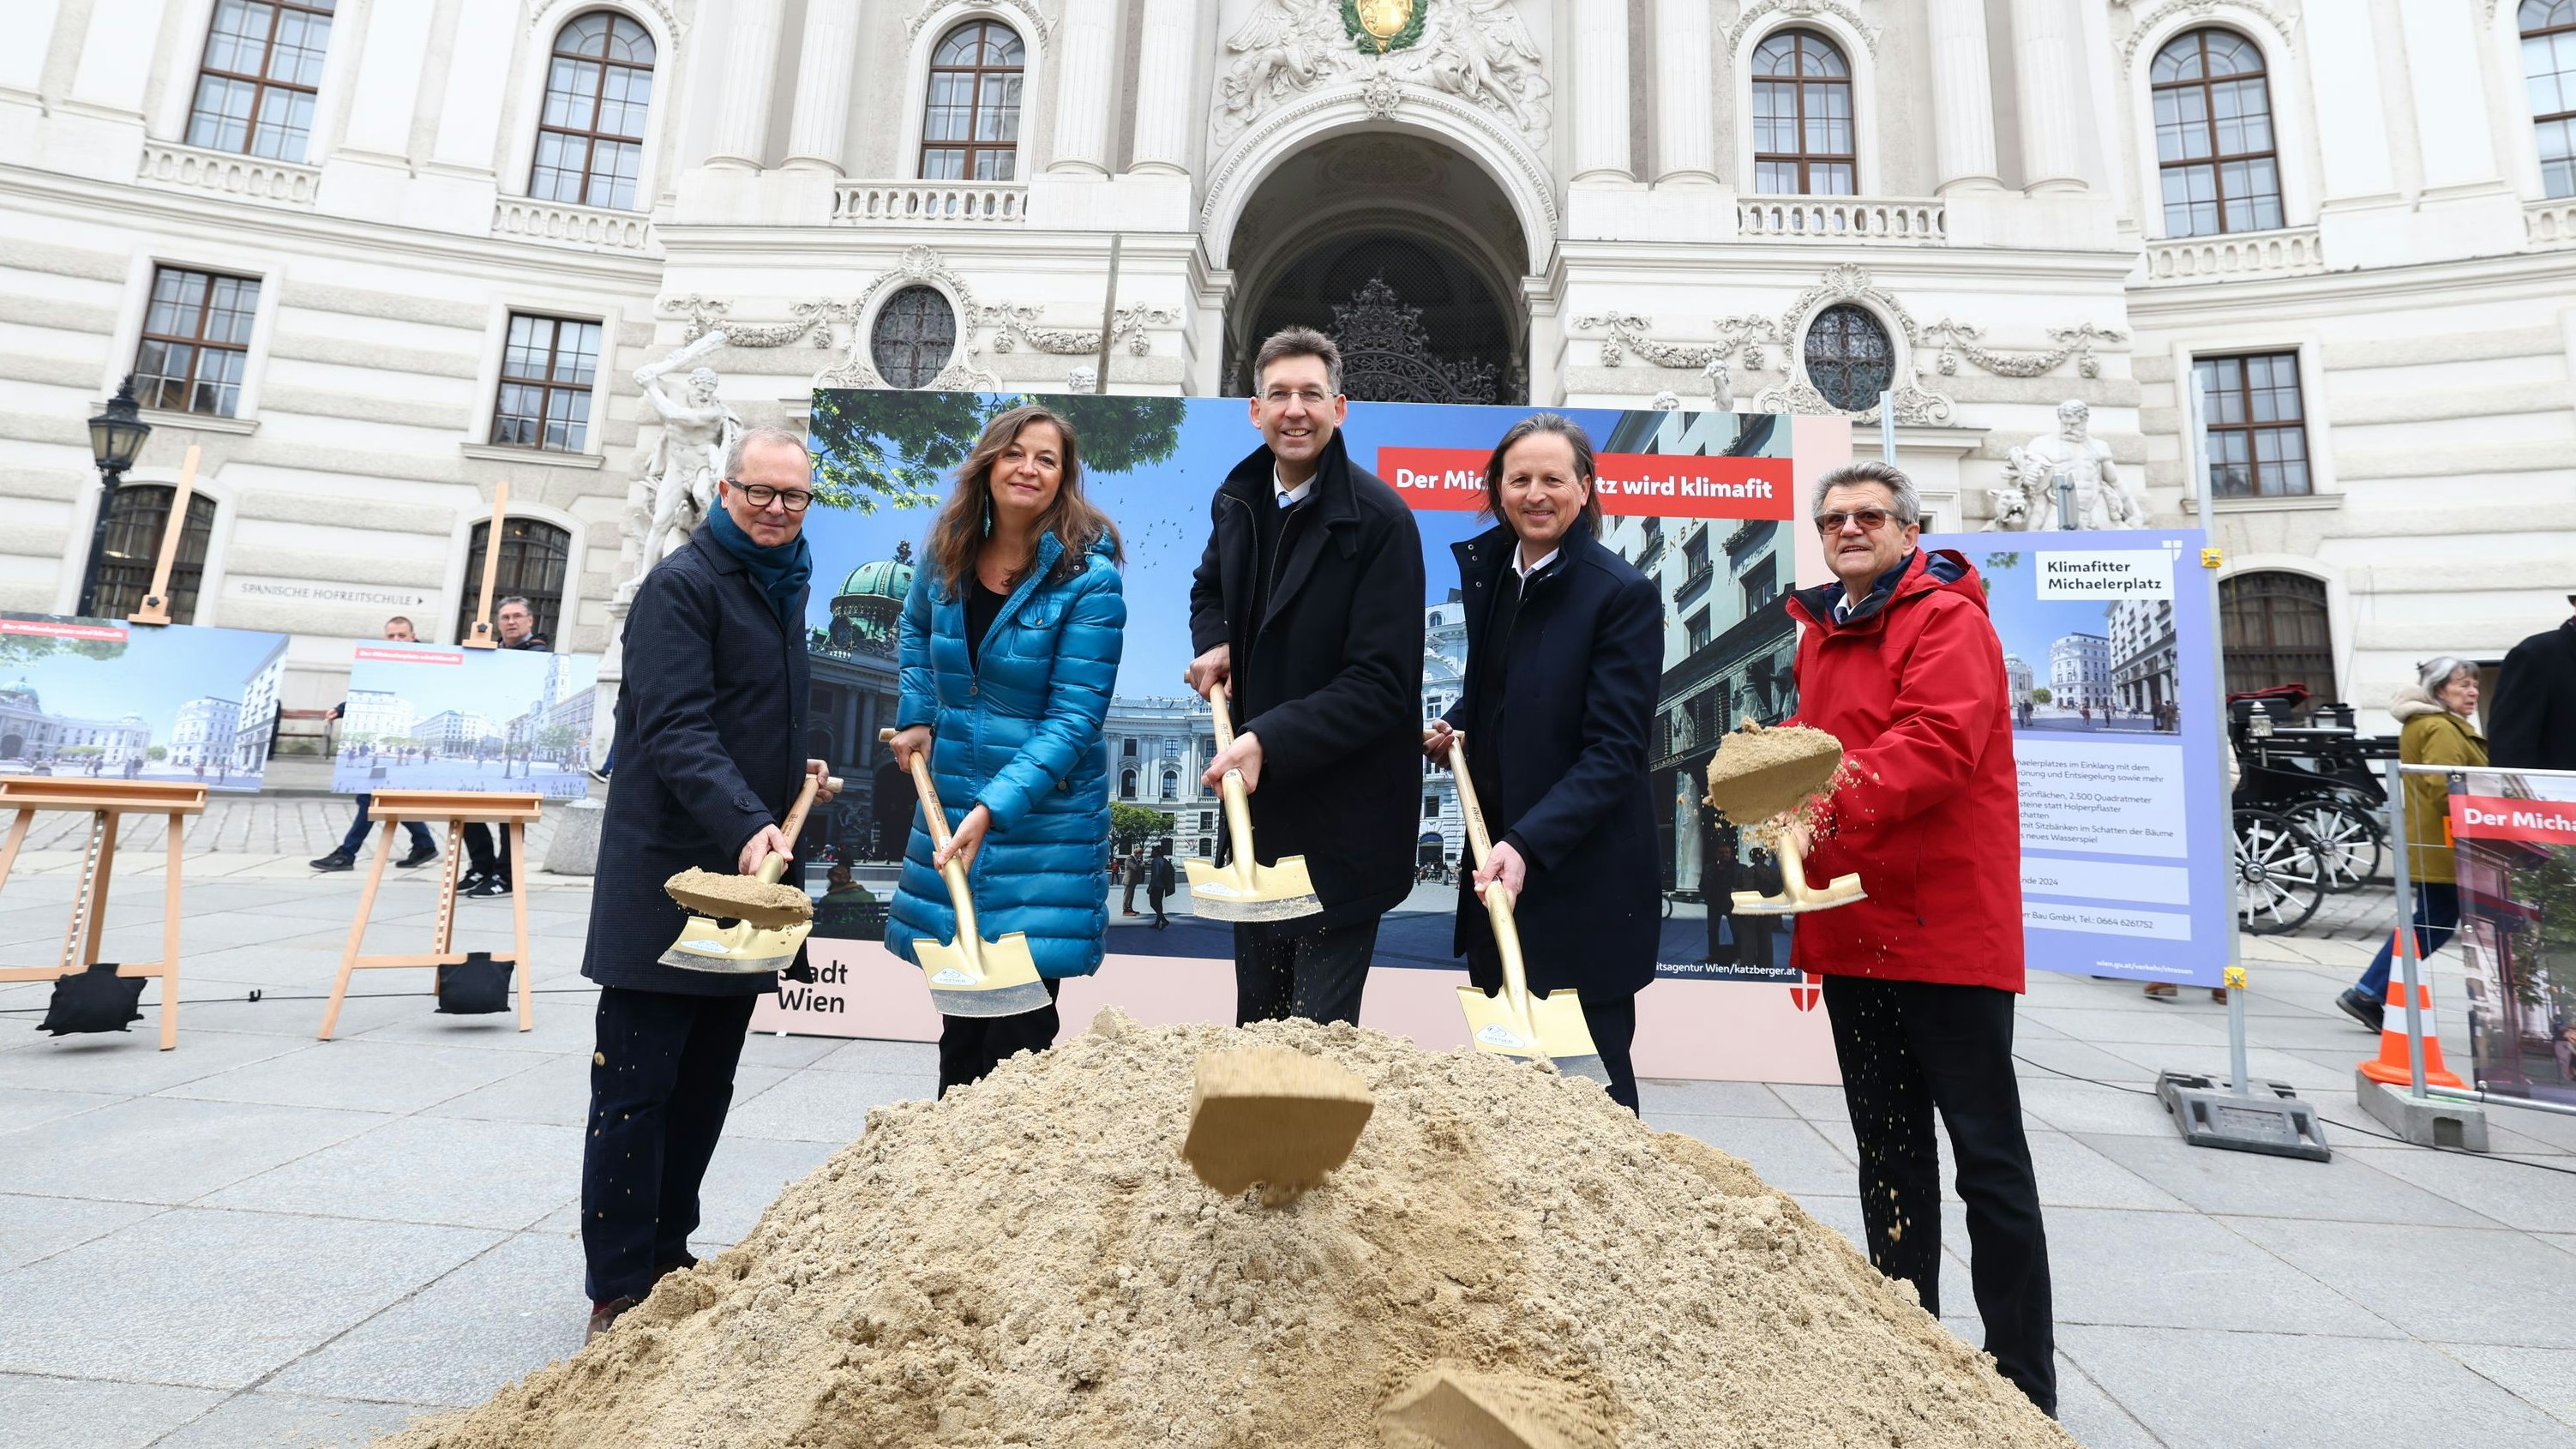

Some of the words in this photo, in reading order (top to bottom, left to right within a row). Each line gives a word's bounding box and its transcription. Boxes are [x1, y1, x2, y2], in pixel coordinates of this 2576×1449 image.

[1396, 468, 1439, 489] Der
[1623, 475, 1675, 496] wird
[1681, 476, 1773, 499] klimafit
[2047, 560, 2131, 573] Klimafitter
[2048, 577, 2162, 592] Michaelerplatz
[241, 582, 309, 598] SPANISCHE
[312, 588, 411, 606] HOFREITSCHULE
[2016, 759, 2068, 768] haelerplatzes
[2081, 761, 2115, 772] Einklang
[2064, 771, 2116, 782] Entsiegelung
[2069, 792, 2093, 801] 2.500
[2094, 793, 2152, 803] Quadratmeter
[2064, 803, 2122, 813] Holperpflaster
[2464, 808, 2507, 827] Der
[2035, 822, 2078, 833] Sitzbänken
[2092, 826, 2128, 834] Schatten
[2145, 828, 2174, 837] Bäume
[2051, 833, 2098, 844] Wasserspiel
[2039, 877, 2058, 886] 2024
[2033, 911, 2047, 920] Bau
[2049, 913, 2077, 923] GmbH,
[2096, 917, 2118, 925] 0664
[1656, 961, 1703, 973] itsagentur
[1705, 962, 1796, 977] Wien/katzberger.at
[778, 987, 844, 1013] Wien
